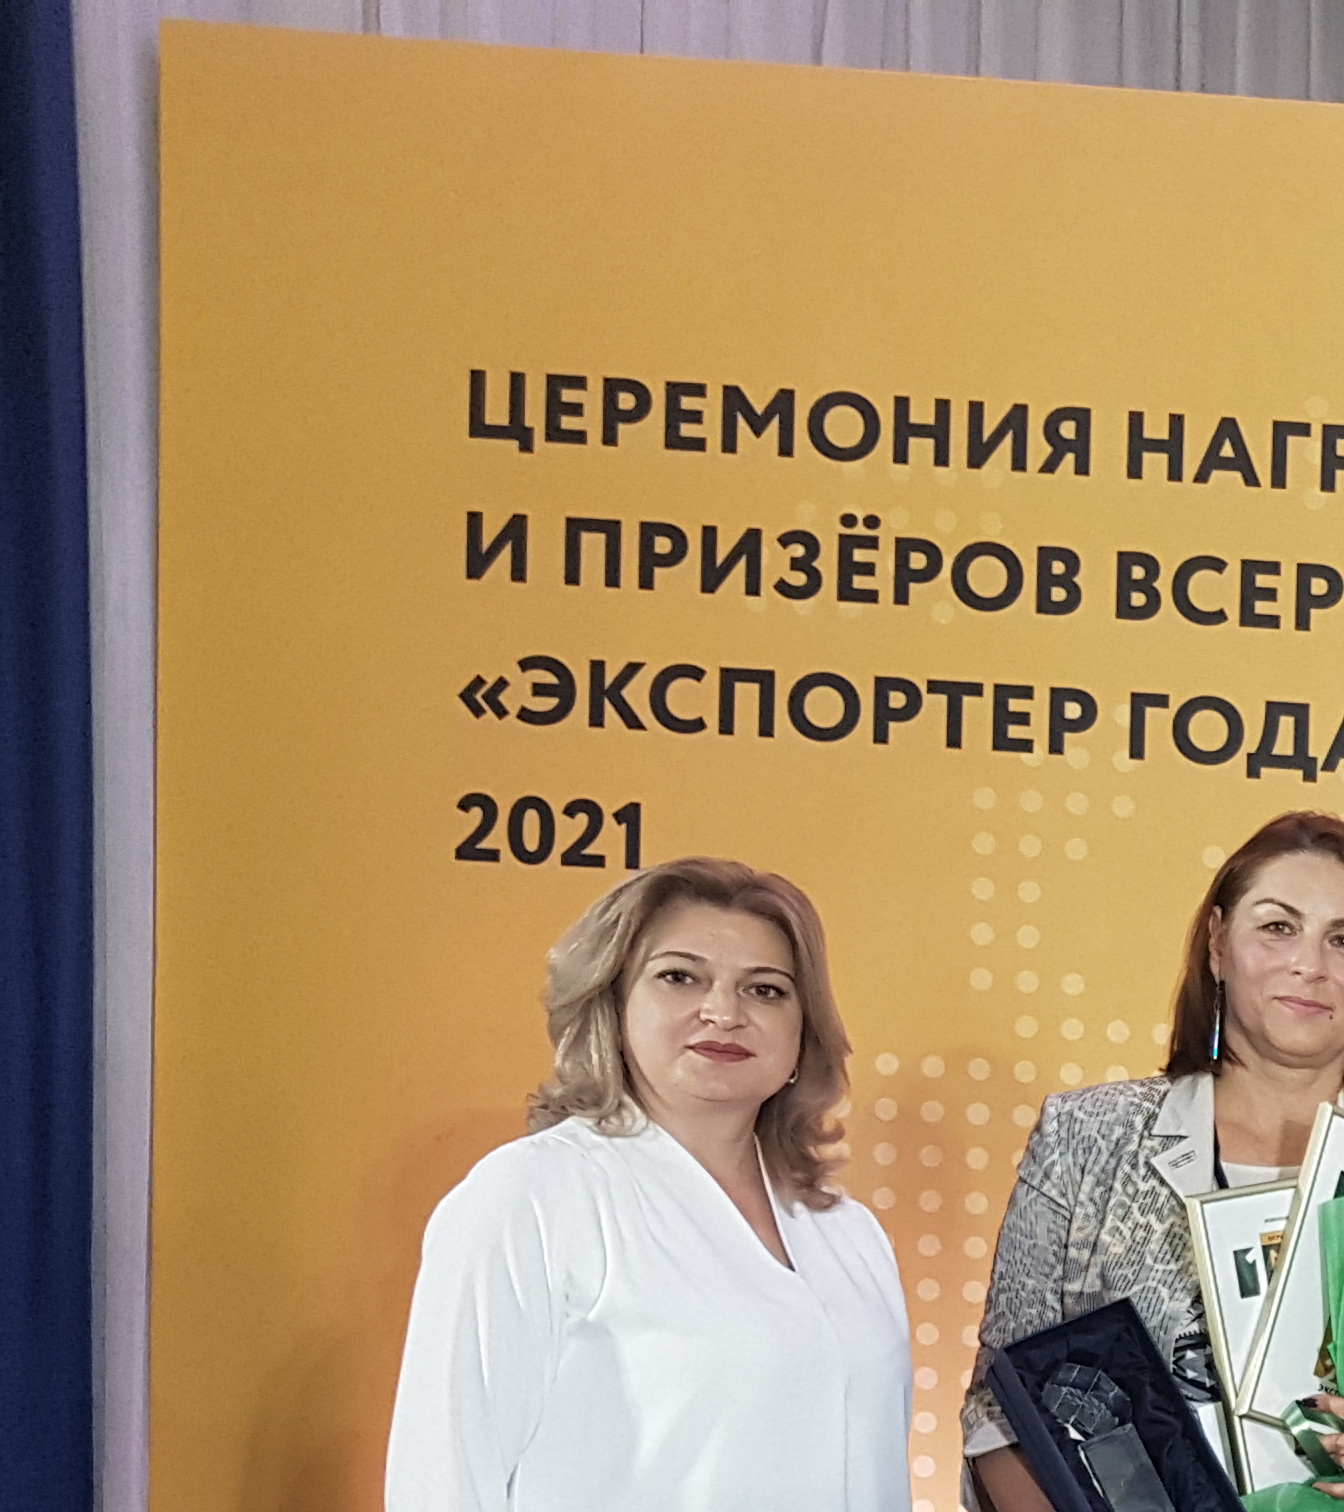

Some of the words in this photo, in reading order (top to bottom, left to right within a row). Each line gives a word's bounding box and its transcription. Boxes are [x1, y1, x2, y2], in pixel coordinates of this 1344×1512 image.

[467, 368, 1092, 477] ЦЕРЕМОНИЯ
[464, 510, 528, 583] И
[563, 512, 1082, 615] ПРИЗЁРОВ
[457, 654, 1098, 756] «ЭКСПОРТЕР
[454, 792, 642, 870] 2021
